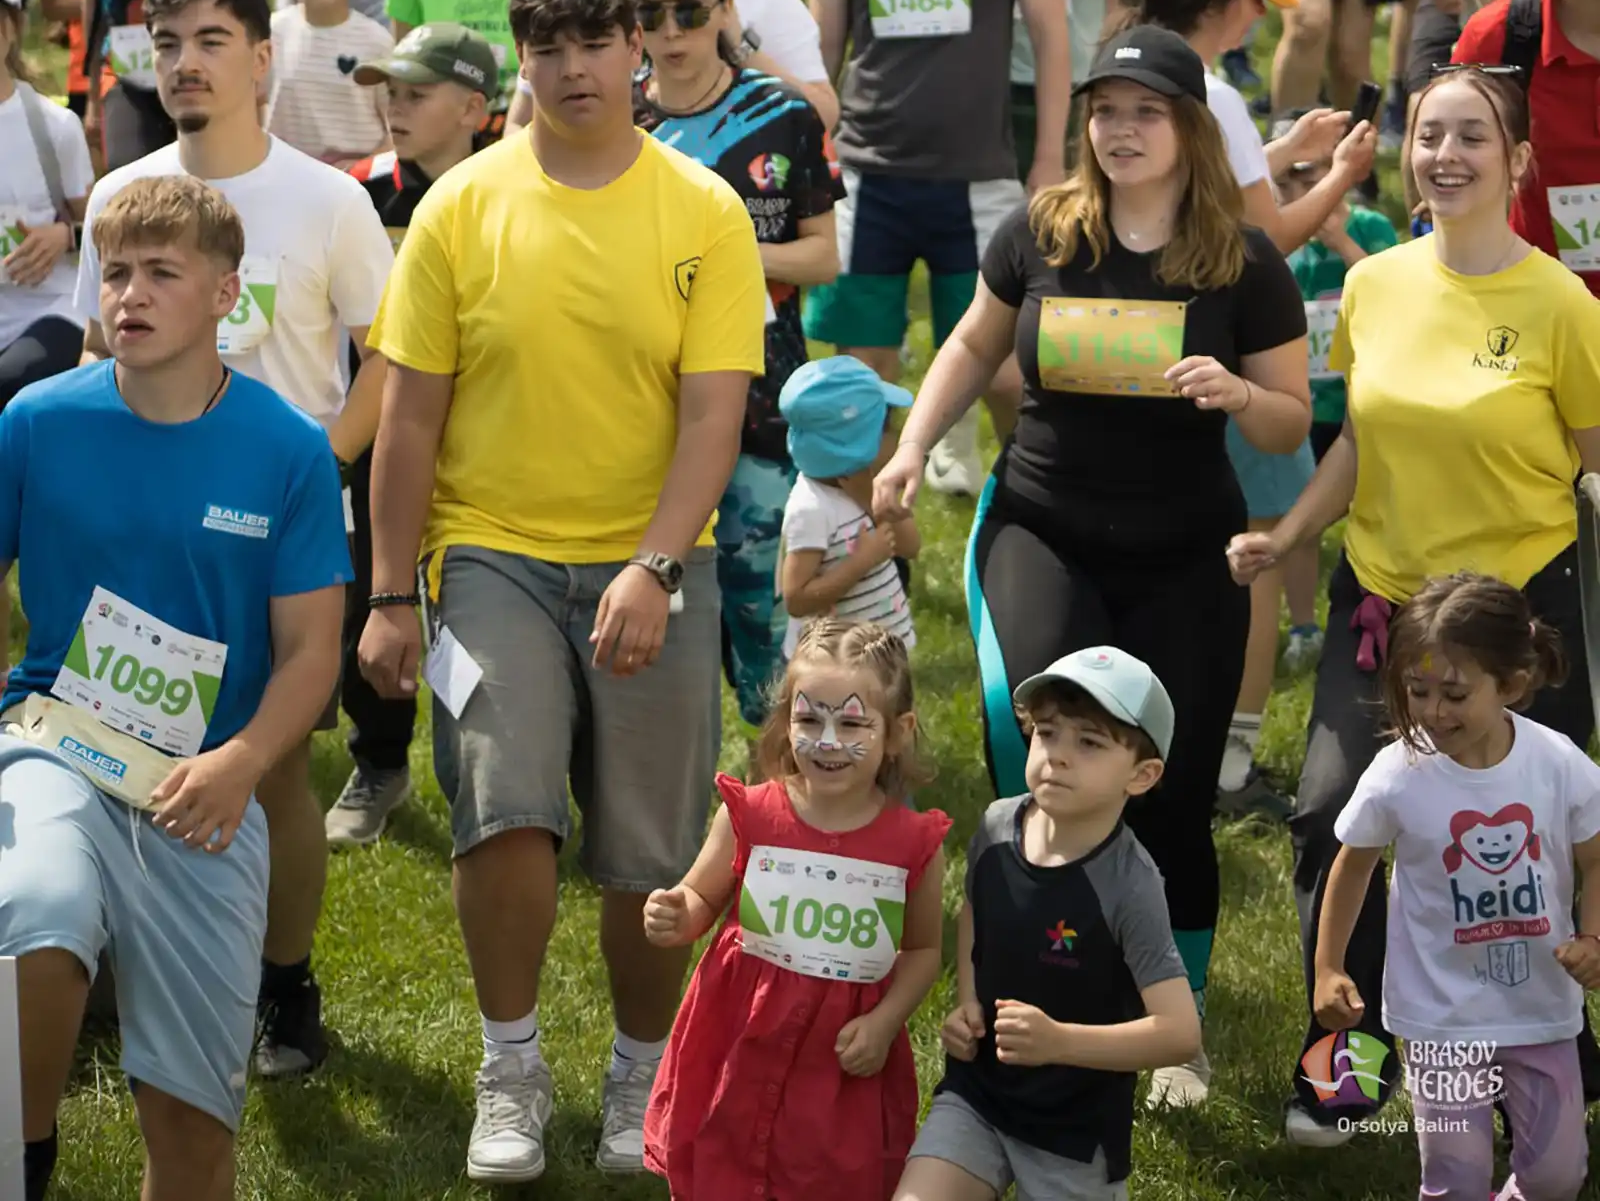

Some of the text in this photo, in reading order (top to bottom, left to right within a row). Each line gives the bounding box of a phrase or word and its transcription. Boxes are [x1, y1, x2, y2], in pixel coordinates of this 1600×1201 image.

[1064, 331, 1159, 365] 1143
[208, 505, 269, 528] BAUER
[93, 644, 194, 717] 1099
[61, 738, 125, 776] BAUER
[1450, 864, 1546, 923] heidi
[769, 895, 879, 949] 1098
